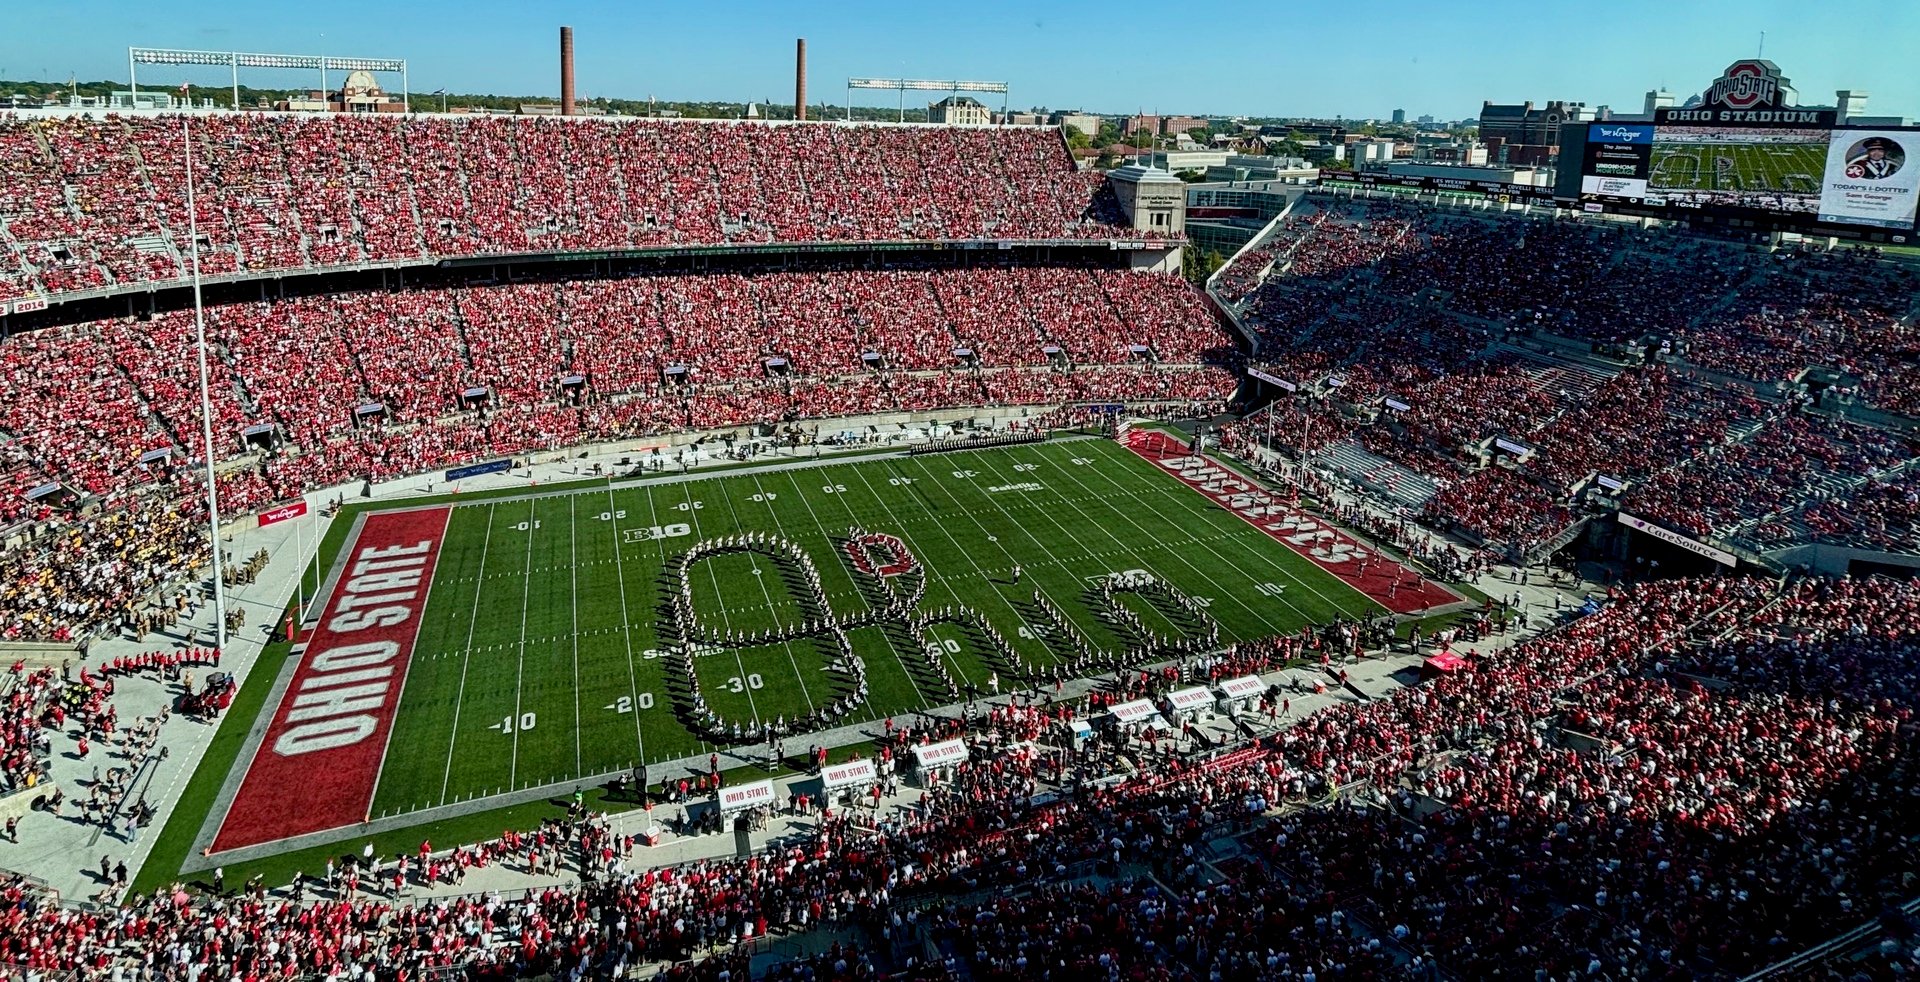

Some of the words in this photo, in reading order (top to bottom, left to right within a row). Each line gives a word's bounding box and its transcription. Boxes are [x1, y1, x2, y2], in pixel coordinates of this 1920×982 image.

[1712, 77, 1739, 104] OHIO
[1739, 73, 1774, 105] STATE
[1667, 110, 1713, 121] OHIO
[1719, 110, 1819, 123] STADIUM
[1612, 127, 1641, 141] Kroger
[1864, 193, 1892, 201] George
[18, 300, 44, 311] 2014
[1259, 372, 1289, 389] CareSource
[823, 484, 847, 494] 50
[678, 501, 704, 511] 30
[277, 509, 300, 519] Kroger
[601, 510, 627, 521] 20
[1647, 525, 1718, 558] CareSource
[327, 540, 433, 634] STATE
[694, 647, 725, 658] FIELD
[727, 673, 764, 694] 30
[1228, 684, 1242, 693] OHIO
[1243, 680, 1260, 689] STATE
[271, 639, 401, 758] OHIO
[617, 692, 655, 714] 20
[1175, 695, 1189, 704] OHIO
[1190, 690, 1208, 701] STATE
[1116, 708, 1132, 718] OHIO
[1133, 703, 1150, 714] STATE
[502, 711, 537, 734] 10
[922, 750, 940, 761] OHIO
[940, 744, 962, 757] STATE
[828, 770, 847, 782] OHIO
[848, 764, 870, 777] STATE
[725, 791, 745, 803] OHIO
[747, 786, 769, 799] STATE
